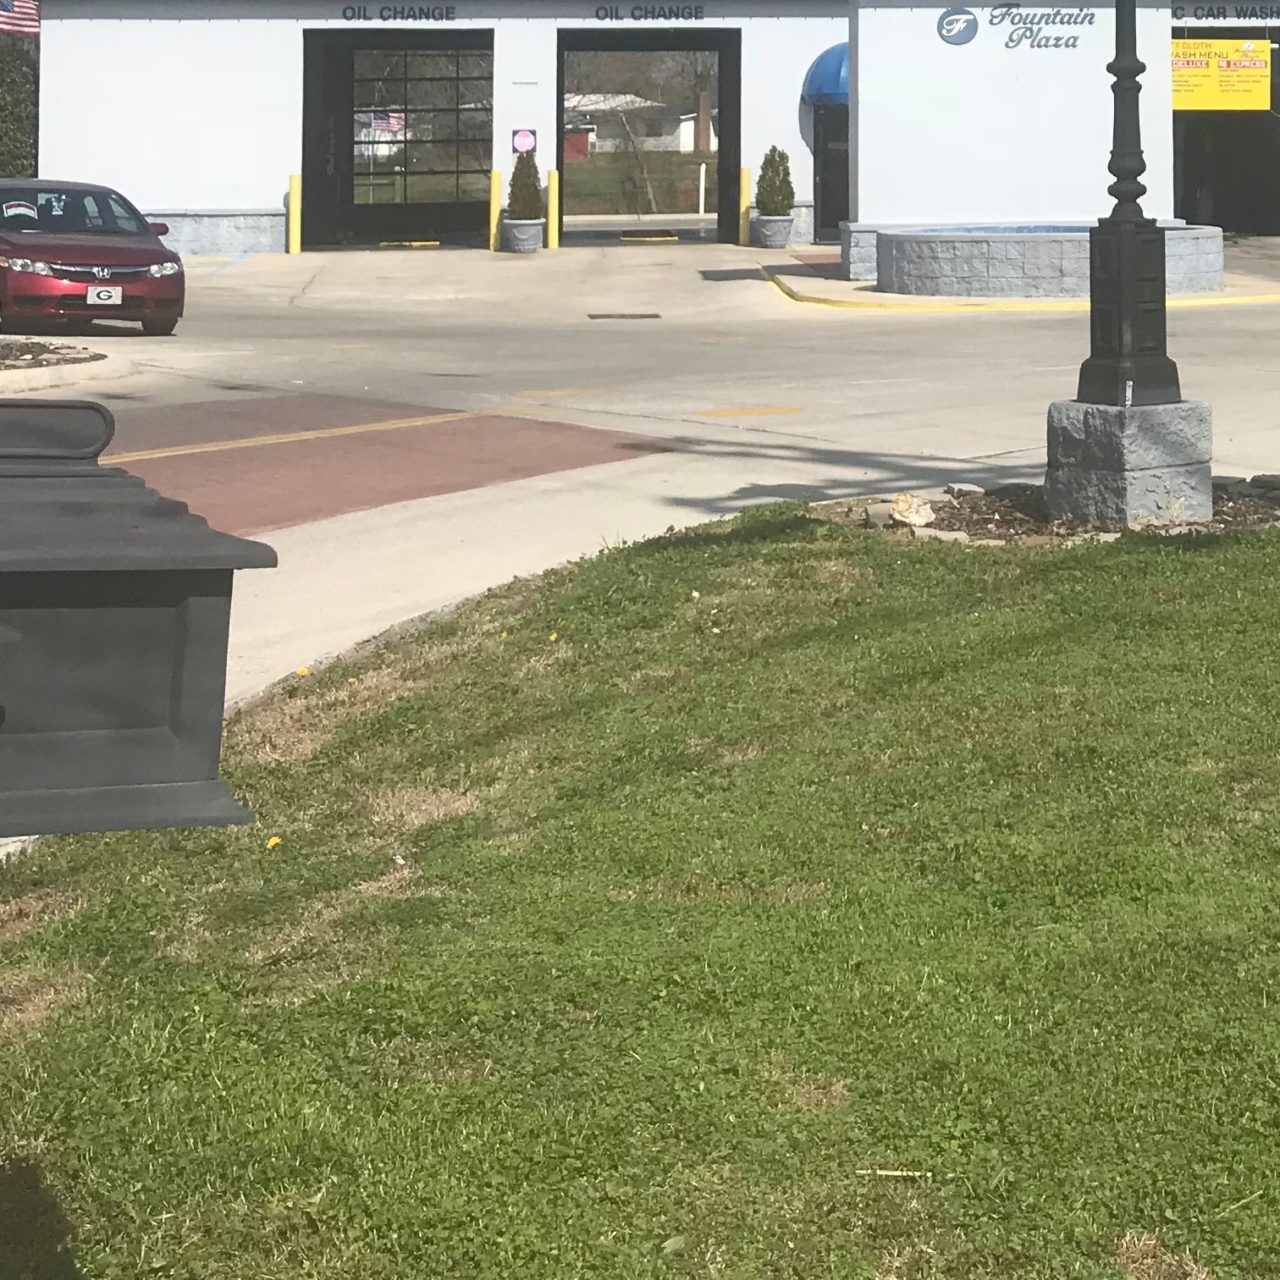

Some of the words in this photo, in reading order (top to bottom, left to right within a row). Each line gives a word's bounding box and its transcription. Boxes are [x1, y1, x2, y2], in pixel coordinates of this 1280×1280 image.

[342, 5, 372, 21] OIL
[380, 6, 457, 21] CHANGE
[596, 5, 624, 21] OIL
[630, 5, 705, 20] CHANGE
[989, 3, 1095, 26] Fountain
[1194, 6, 1227, 20] CAR
[1235, 6, 1280, 20] WASH
[1004, 26, 1080, 49] Plaza
[1172, 51, 1197, 60] ASH
[96, 289, 113, 301] G
